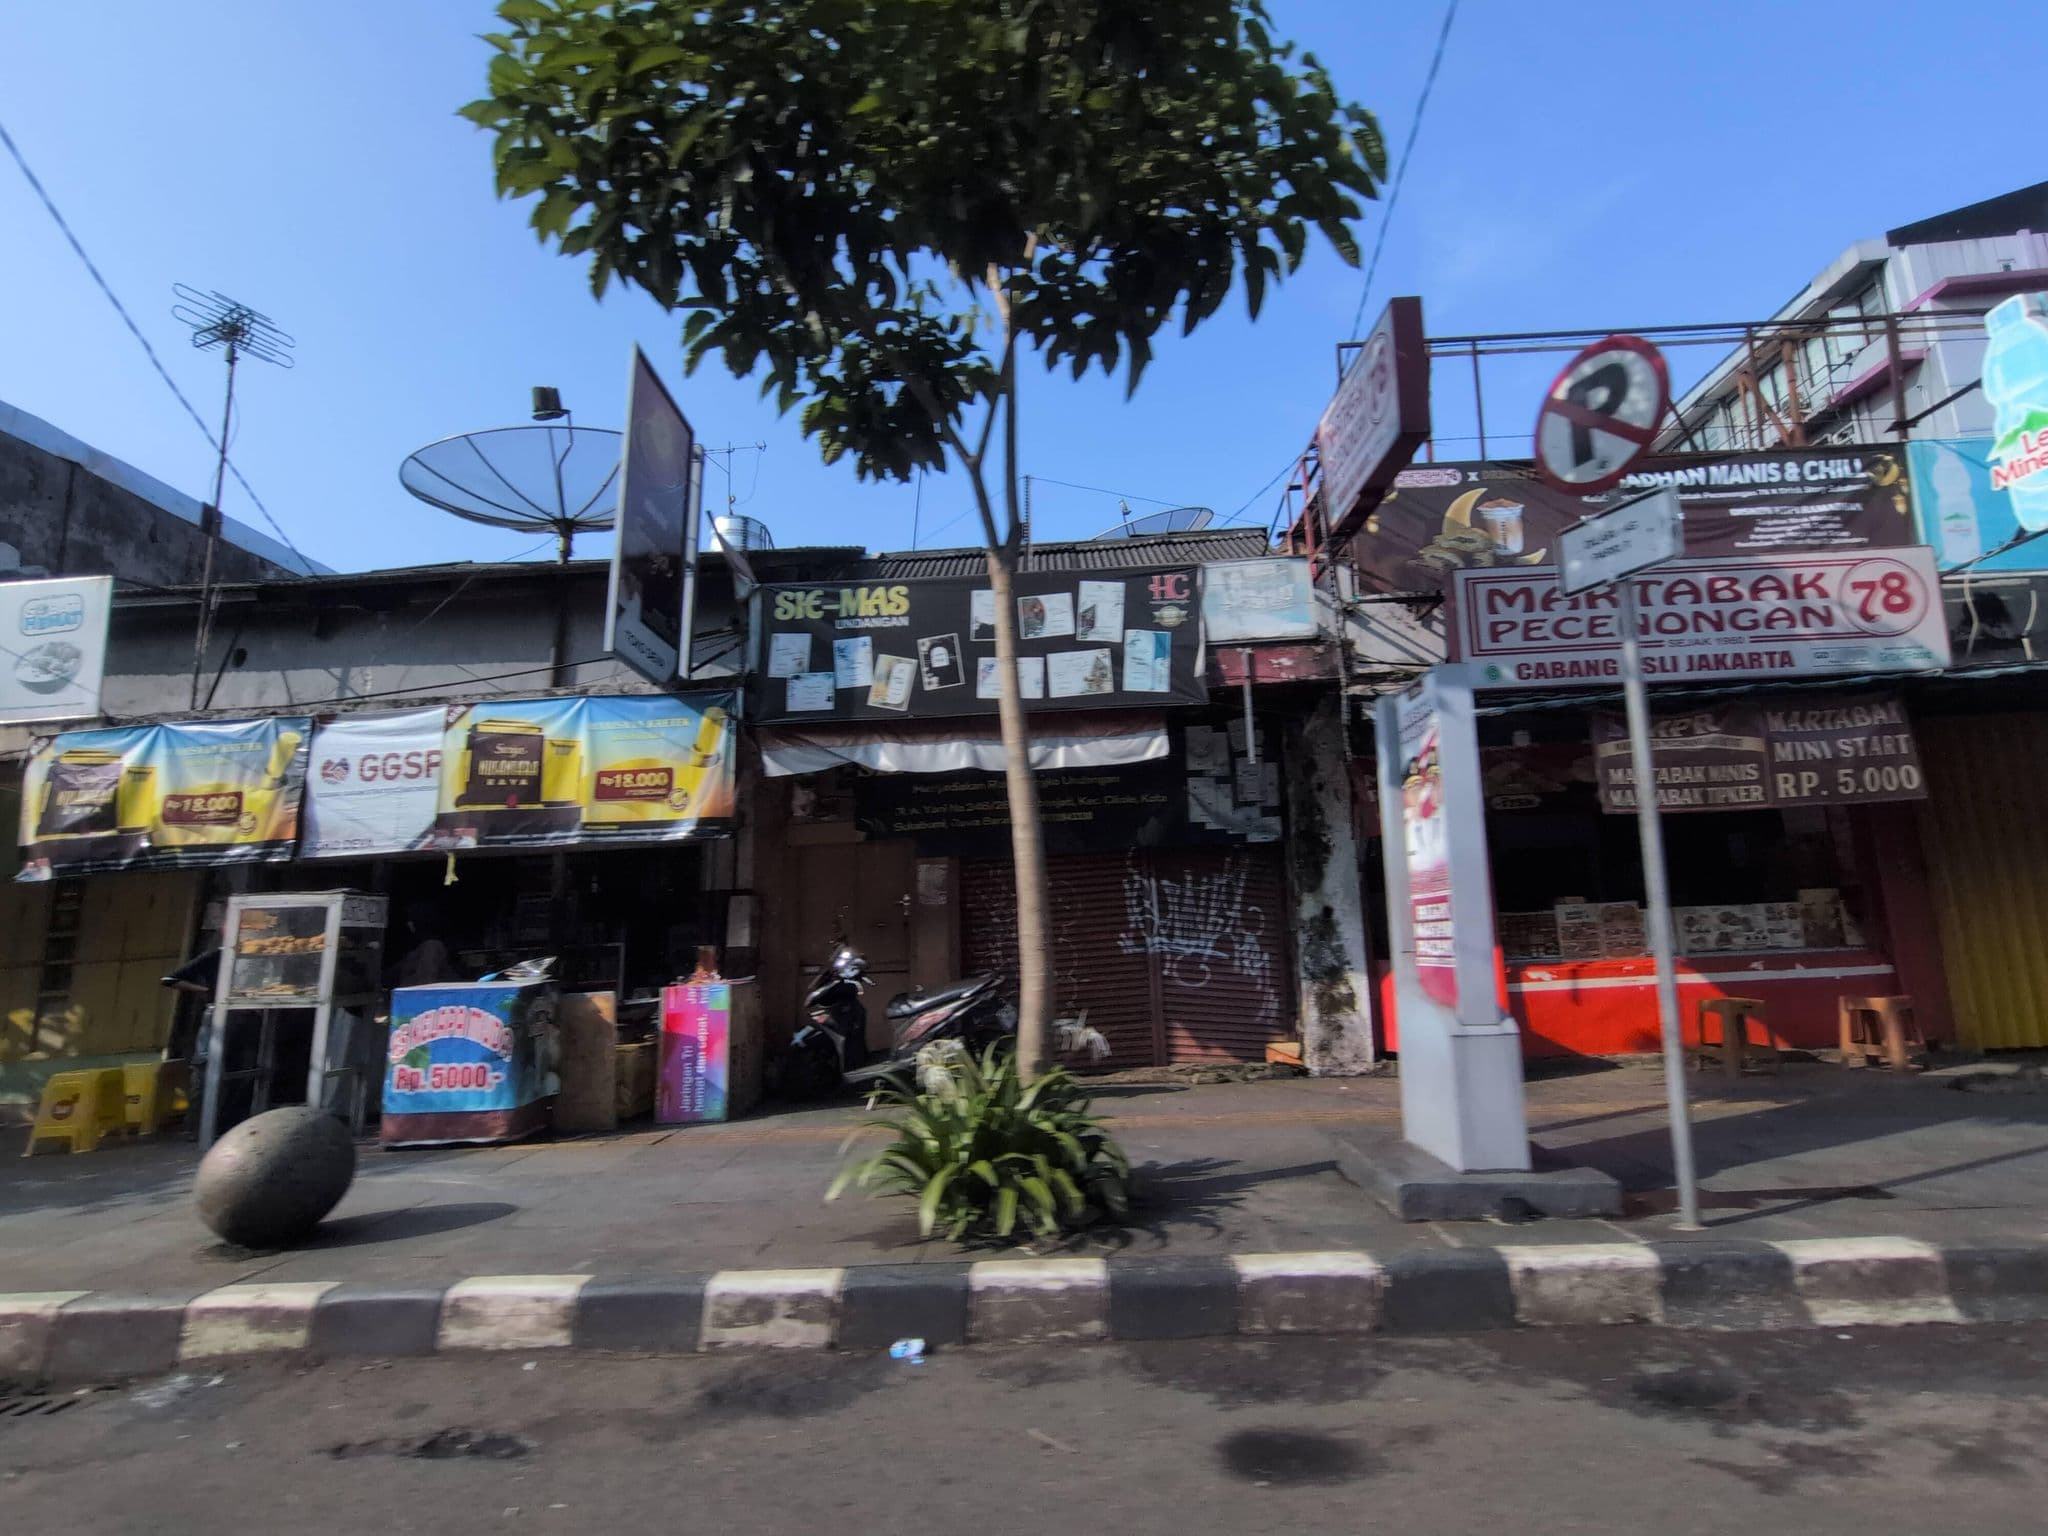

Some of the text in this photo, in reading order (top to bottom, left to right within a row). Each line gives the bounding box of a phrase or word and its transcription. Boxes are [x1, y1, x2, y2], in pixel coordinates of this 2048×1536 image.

[1620, 458, 1872, 488] ADHAN MANIS & CHILL
[1851, 571, 1914, 623] 78
[1517, 658, 1618, 680] CABANG
[1642, 655, 1678, 675] SLI
[1686, 650, 1795, 672] JAKARTA
[1773, 740, 1833, 762] MINI
[1836, 734, 1910, 758] START
[1775, 764, 1922, 798] RP. 5.000
